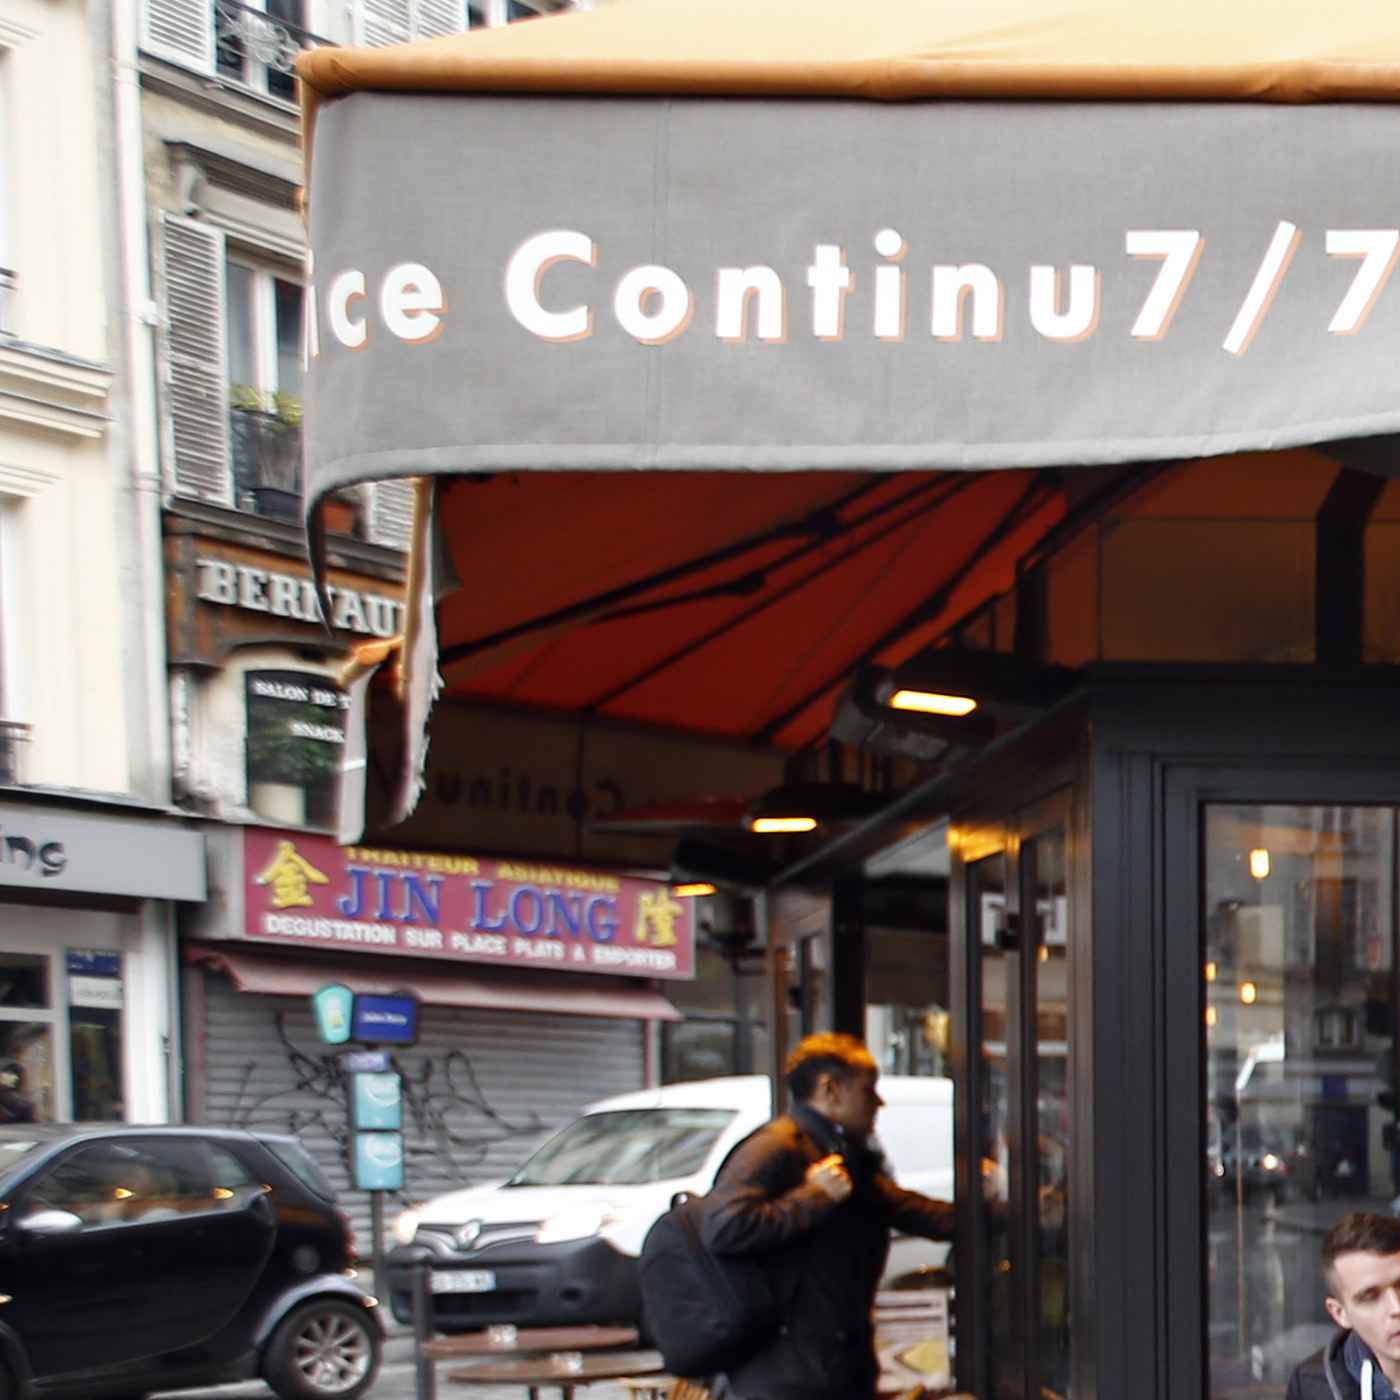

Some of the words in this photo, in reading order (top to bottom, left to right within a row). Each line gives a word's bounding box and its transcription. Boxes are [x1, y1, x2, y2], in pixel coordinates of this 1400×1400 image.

[254, 839, 330, 909] 金
[345, 845, 481, 876] TRAITEUR
[497, 861, 621, 893] ASIATIQUE
[337, 864, 446, 925] JIN
[469, 879, 619, 943] LONG
[264, 914, 396, 946] DEGUSTATION
[406, 925, 444, 949] SUR
[452, 933, 507, 957] PLACE
[514, 938, 565, 961] PLATS
